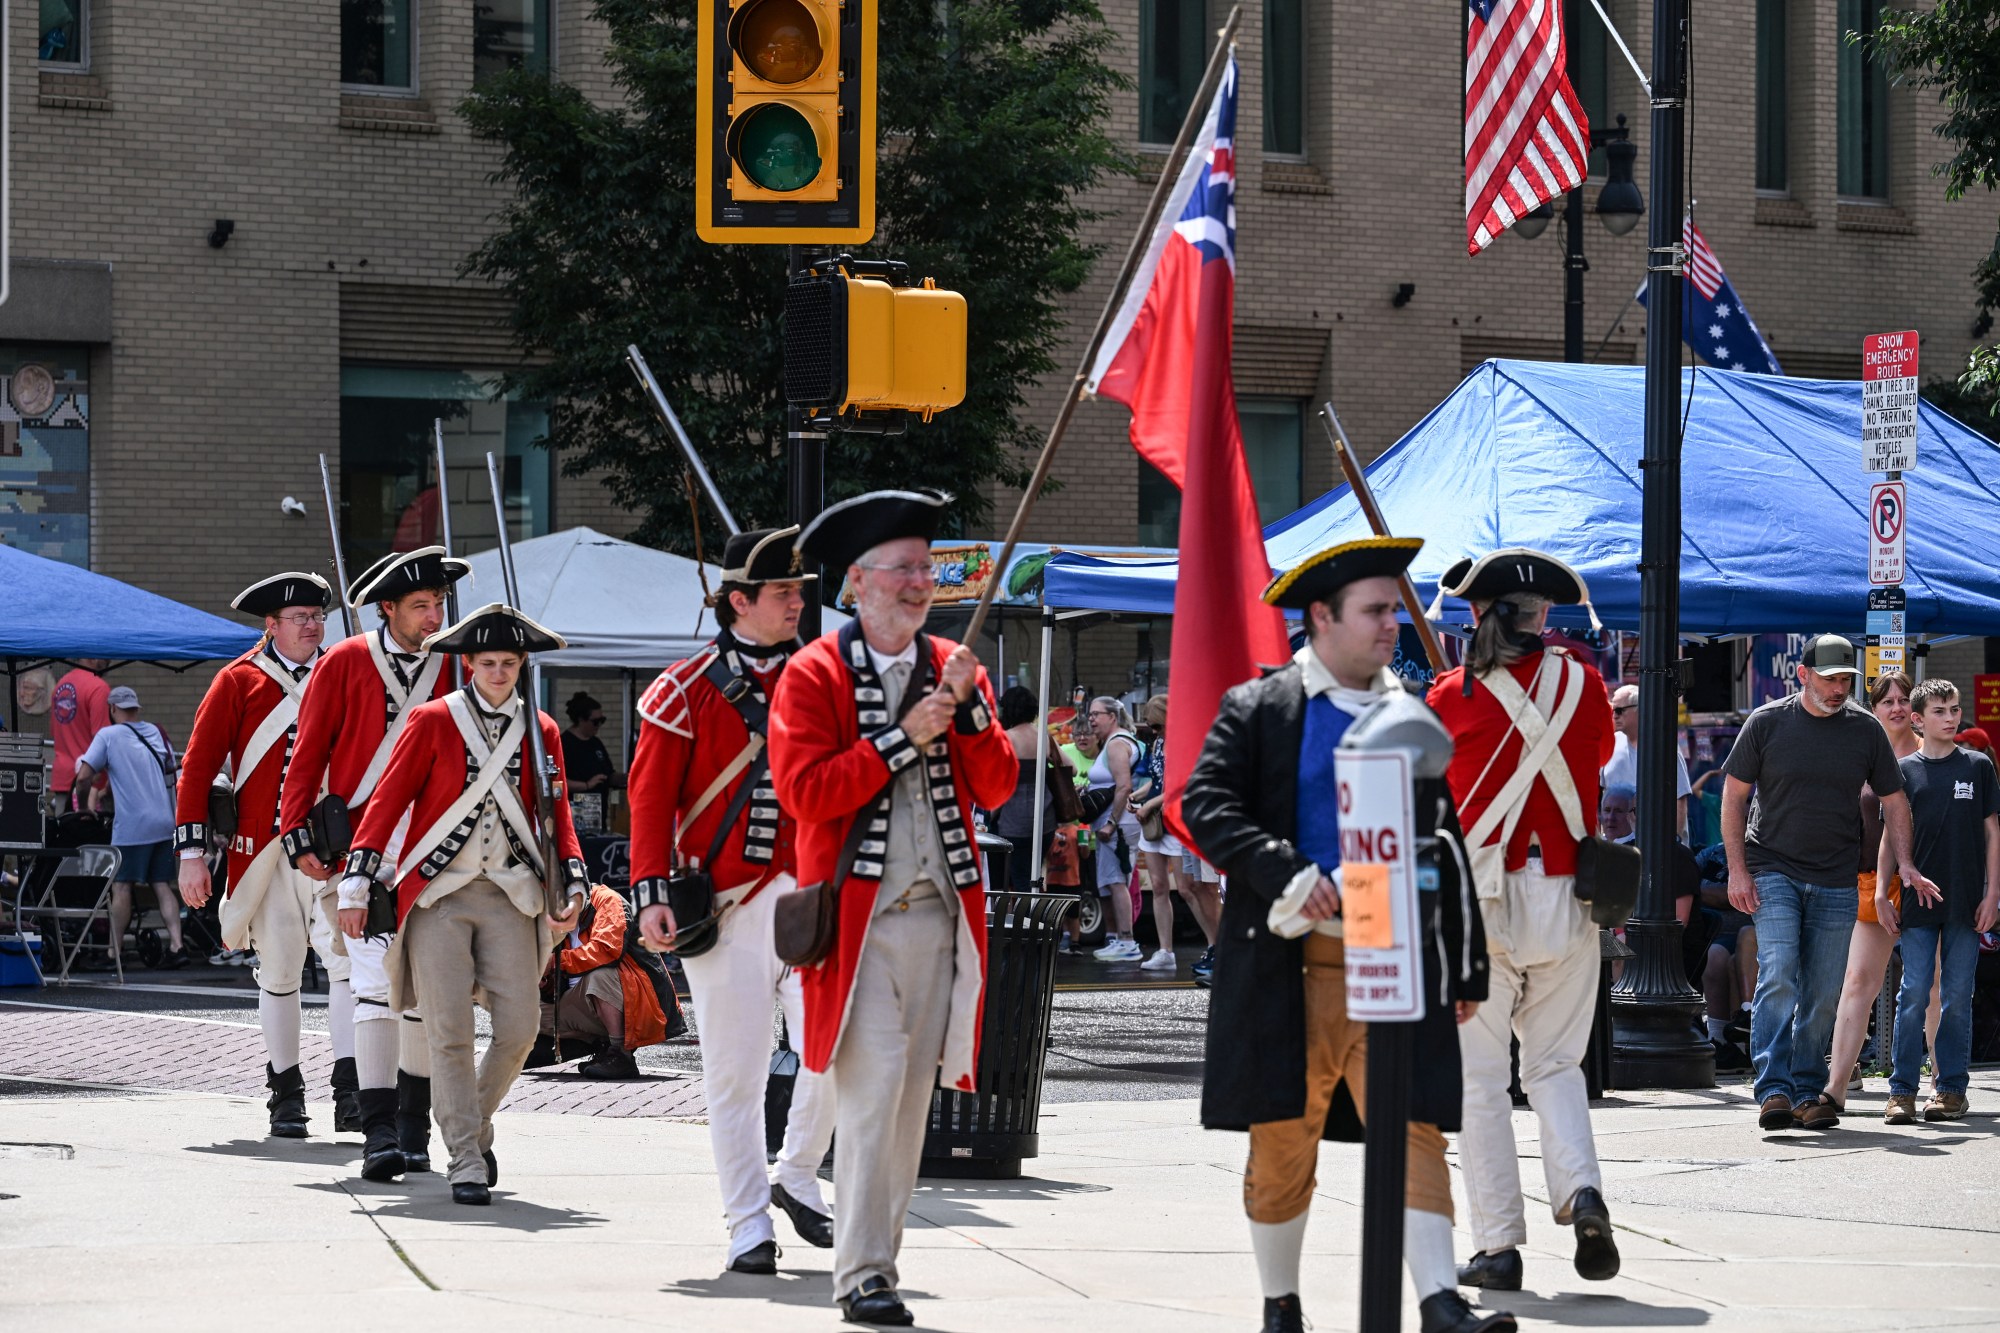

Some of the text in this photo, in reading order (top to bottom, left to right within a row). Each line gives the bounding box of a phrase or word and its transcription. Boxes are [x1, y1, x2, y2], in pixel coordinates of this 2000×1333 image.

[1878, 334, 1903, 348] SNOW
[1866, 348, 1914, 365] EMERGENCY
[1876, 364, 1902, 379] ROUTE
[1865, 378, 1914, 394] SNOW TIRES OR
[1862, 393, 1916, 409] CHAINS REQUIRED
[1866, 410, 1911, 425] NO PARKING
[1862, 425, 1916, 441] DURING EMERGENCY
[1875, 441, 1902, 455] VEHICLES
[1869, 456, 1908, 471] TOWED AWAY
[1879, 547, 1894, 555] MONDAY
[939, 564, 965, 585] ICE
[1881, 637, 1903, 645] 104100
[1340, 827, 1398, 862] KING
